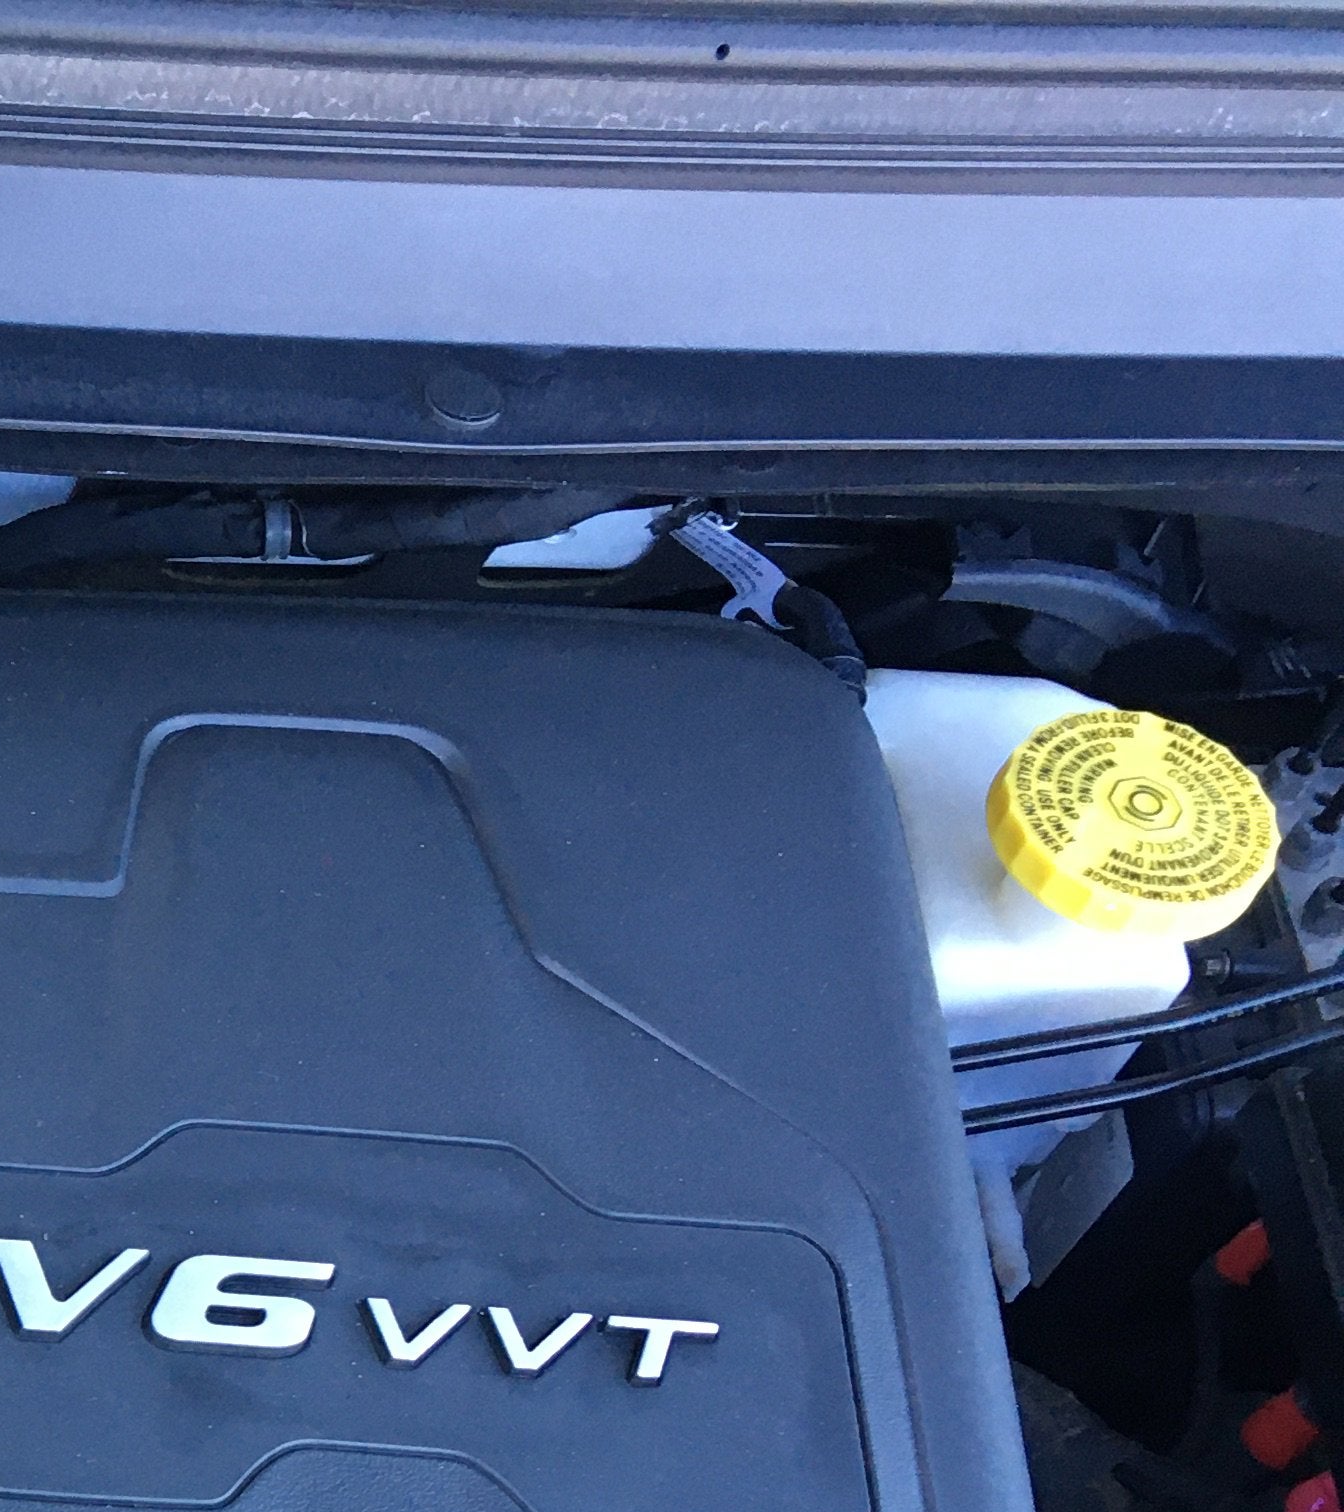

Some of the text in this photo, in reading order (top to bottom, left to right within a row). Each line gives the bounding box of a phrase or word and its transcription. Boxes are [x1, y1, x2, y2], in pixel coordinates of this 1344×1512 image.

[1079, 727, 1135, 743] BEFORE
[1162, 752, 1185, 767] DU
[1016, 711, 1140, 854] DOT 3 FLUID FROM A SEALED CONTAINER
[1036, 789, 1056, 811] USE
[1057, 742, 1116, 820] CLEAN FILLER CAP
[1077, 759, 1118, 803] WARNING
[1182, 764, 1226, 805] LIQUIDE
[1082, 722, 1271, 903] MISE EN GARDE NETTOYER LE BOUCHON DE REMPLISSAGE
[1100, 740, 1251, 886] AVANT DE LE RETIRER UTILISER UNIQUEMENT
[1167, 769, 1209, 842] CONTENANT
[1215, 809, 1231, 834] DOT
[1046, 815, 1076, 843] ONLY
[1149, 839, 1224, 872] PROVENANT
[362, 1297, 720, 1386] VVT
